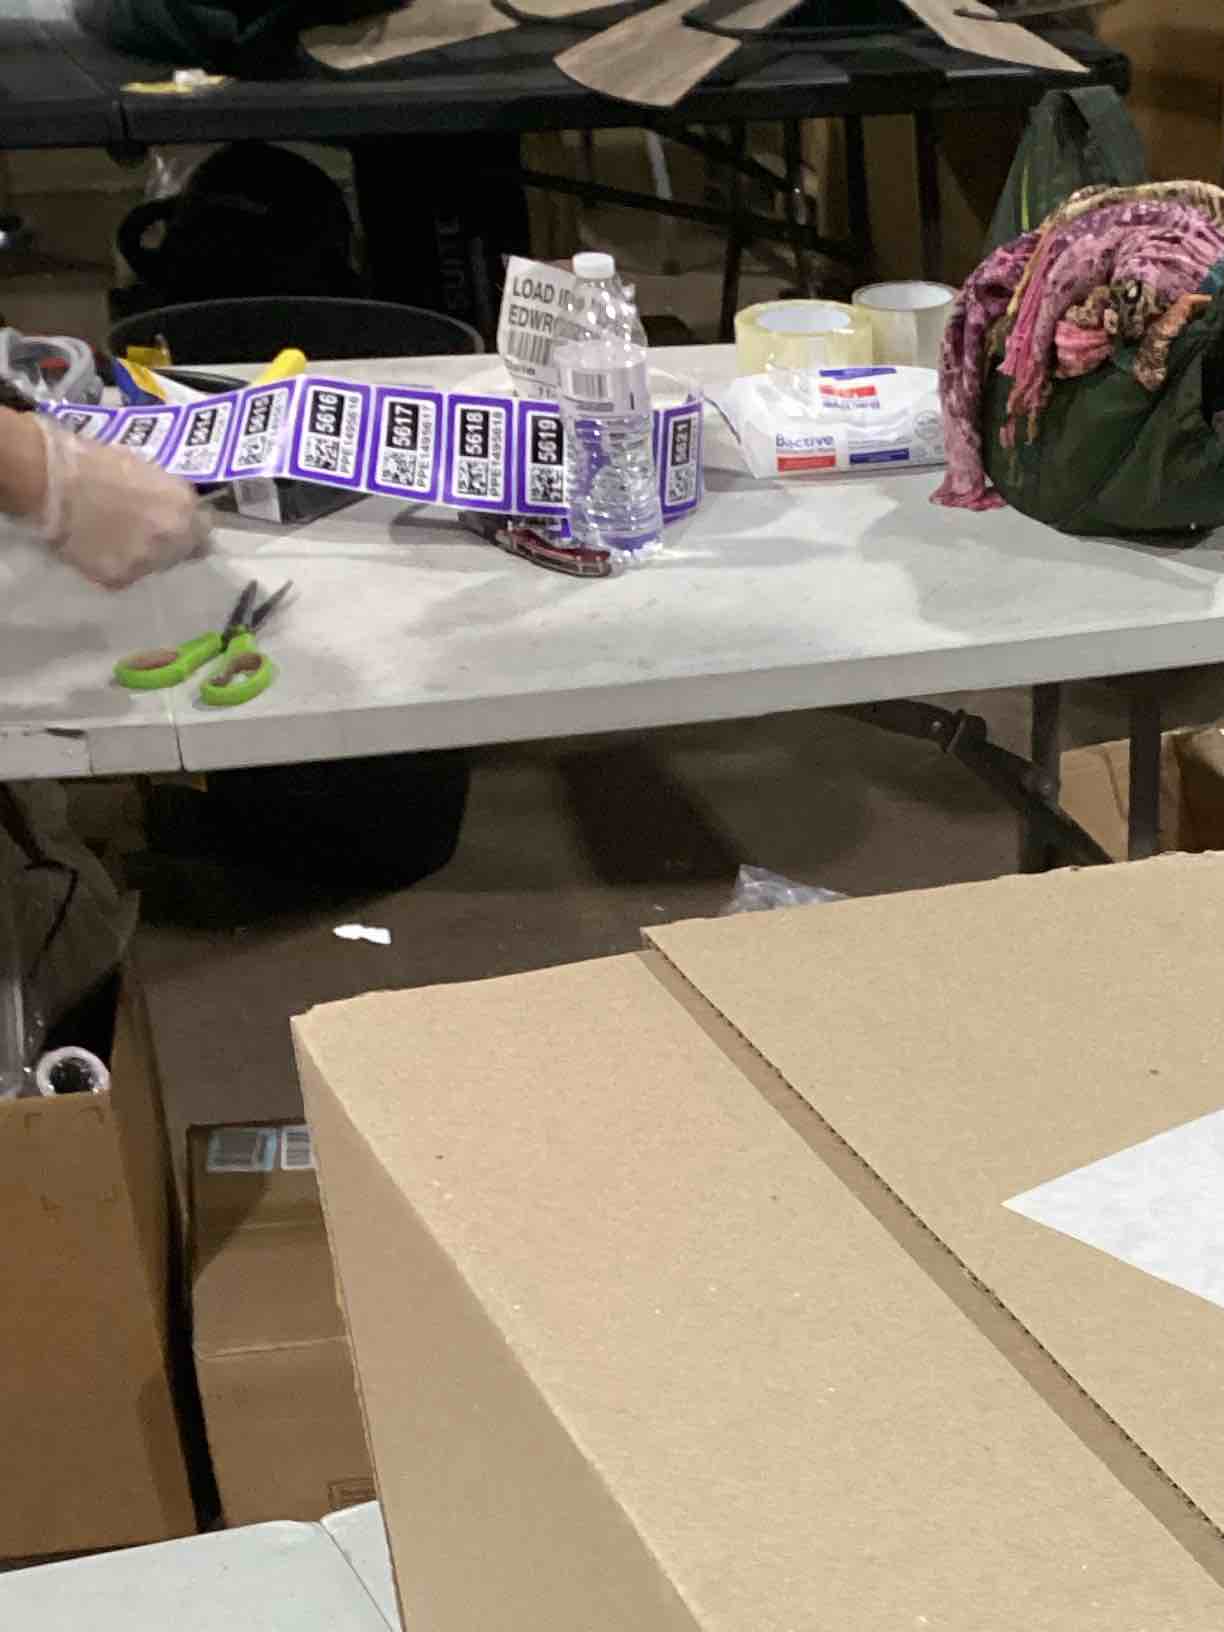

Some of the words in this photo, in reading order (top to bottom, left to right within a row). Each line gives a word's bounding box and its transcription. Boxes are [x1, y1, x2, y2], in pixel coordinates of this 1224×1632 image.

[512, 276, 555, 304] LOAD
[315, 392, 339, 435] 5616
[391, 404, 413, 447] 5617
[464, 411, 484, 455] 5618
[537, 418, 558, 463] 5619
